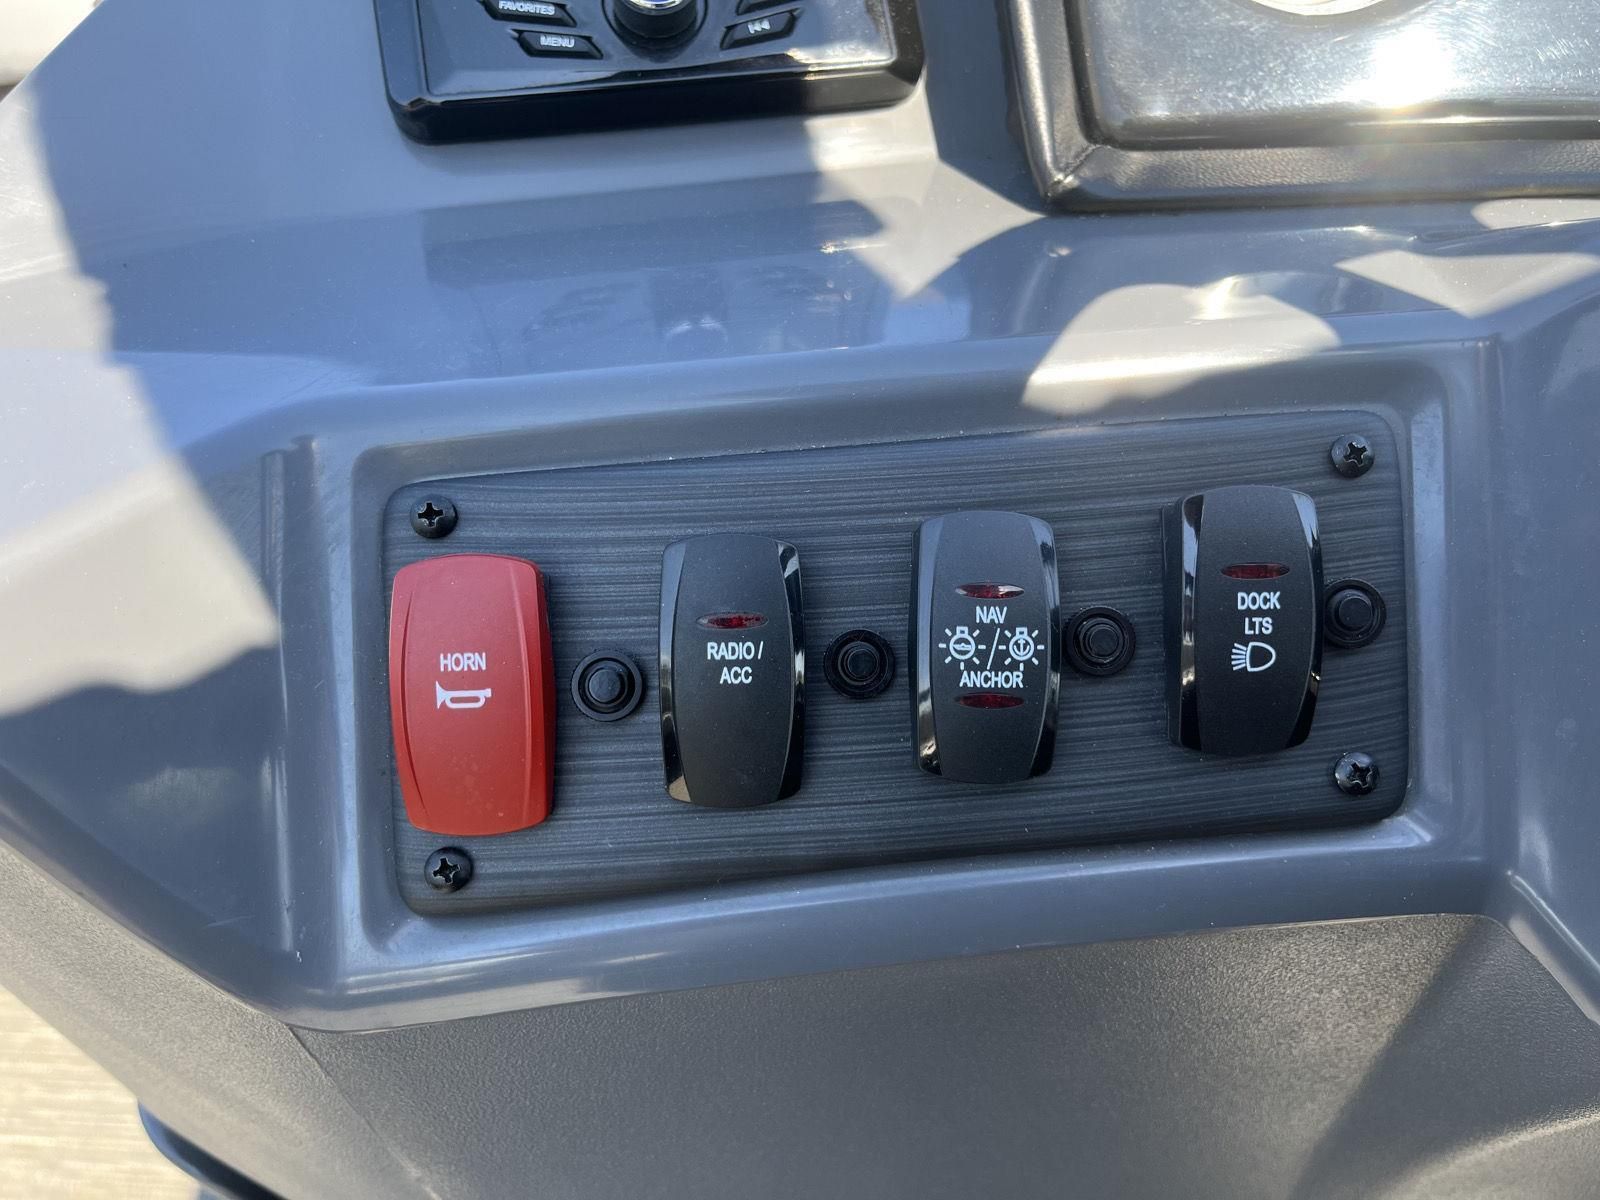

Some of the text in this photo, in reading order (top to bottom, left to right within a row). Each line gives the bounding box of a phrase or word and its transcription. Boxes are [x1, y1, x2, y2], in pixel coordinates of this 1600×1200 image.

[499, 0, 555, 15] FAVORITES
[540, 34, 575, 48] MENU
[1237, 591, 1281, 610] DOCK
[975, 605, 1008, 624] NAV
[1244, 617, 1273, 635] LTS
[440, 652, 487, 672] HORN
[719, 666, 753, 685] ACC
[959, 670, 1024, 688] ANCHOR
